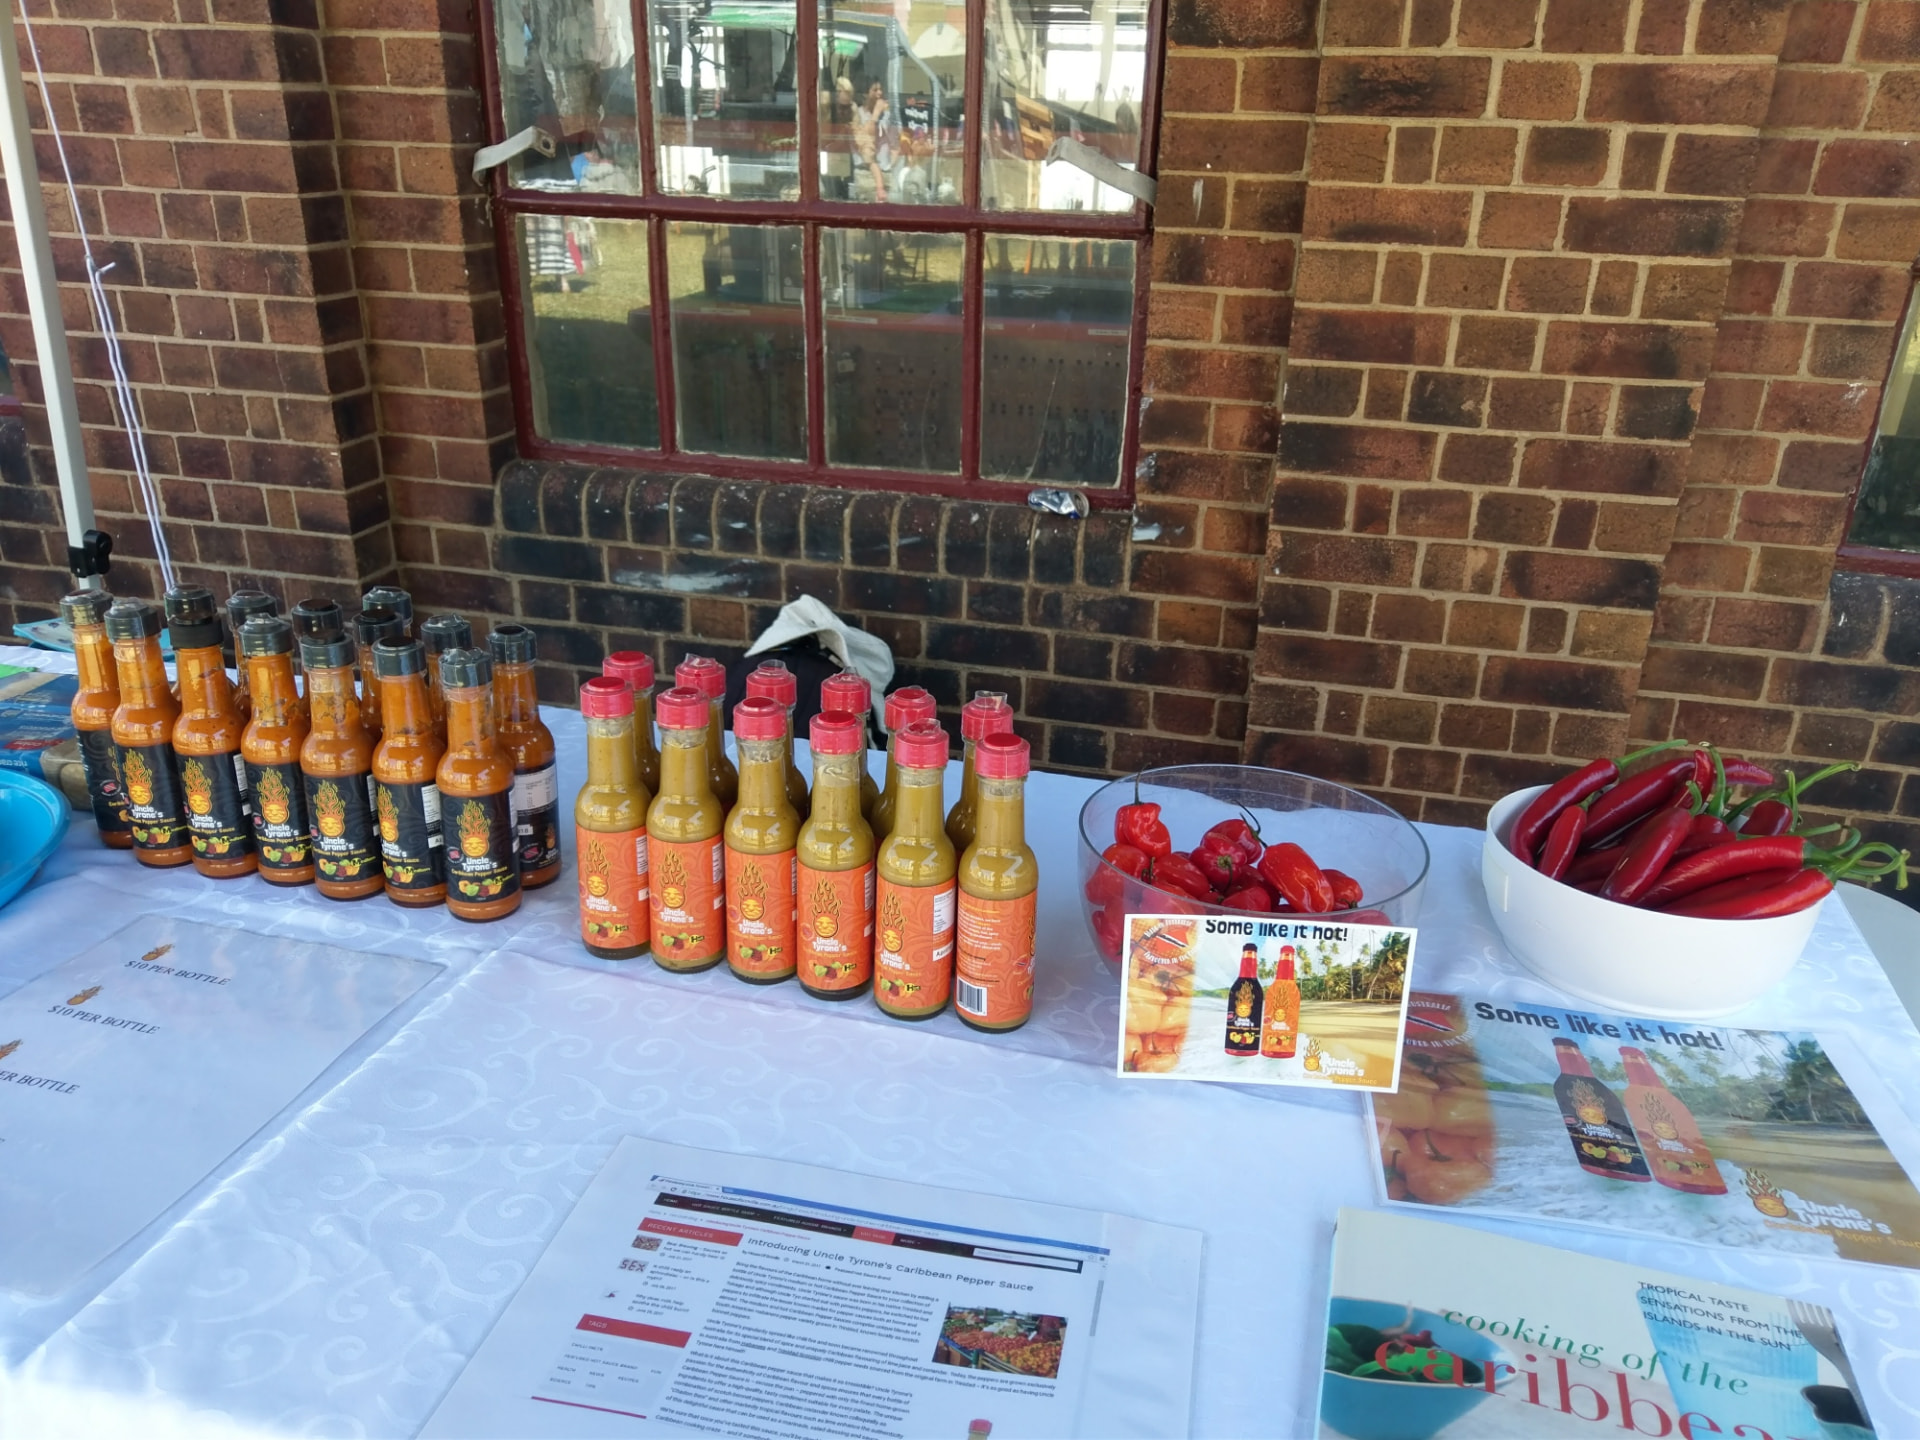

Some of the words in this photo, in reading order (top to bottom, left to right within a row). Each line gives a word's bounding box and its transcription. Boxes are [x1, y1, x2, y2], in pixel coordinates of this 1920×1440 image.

[1205, 919, 1253, 935] Some
[123, 960, 149, 970] $10
[147, 964, 175, 974] PER
[173, 969, 231, 985] BOTTLE
[47, 1004, 74, 1016] $10
[71, 1009, 101, 1022] PER
[100, 1016, 160, 1034] BOTTLE
[1474, 1001, 1560, 1030] Some
[1564, 1013, 1621, 1038] like
[1625, 1021, 1655, 1042] it
[1657, 1025, 1725, 1051] hot!
[1321, 1065, 1364, 1076] Tyrone's
[1329, 1058, 1355, 1067] Uncle
[0, 1070, 18, 1081] ER
[16, 1074, 80, 1094] BOTTLE
[1804, 1200, 1862, 1219] Uncle
[647, 1223, 675, 1233] RECENT
[678, 1228, 713, 1239] ARTICLES
[1799, 1210, 1892, 1234] Tyrone's
[620, 1259, 645, 1273] SEX
[747, 1235, 810, 1257] Introducing
[813, 1248, 845, 1263] Uncle
[848, 1254, 892, 1271] Tyrone's
[895, 1262, 952, 1280] Caribbean
[955, 1272, 995, 1290] Pepper
[998, 1279, 1034, 1293] Sauce
[1637, 1281, 1705, 1303] TROPICAL
[1708, 1296, 1750, 1312] TASTE
[588, 1321, 607, 1329] TAGS
[1640, 1295, 1725, 1321] SENSATIONS
[1730, 1315, 1769, 1331] FROM
[1774, 1324, 1803, 1339] THE
[1643, 1311, 1701, 1331] ISLANDS
[1706, 1324, 1722, 1336] IN
[1725, 1329, 1755, 1343] THE
[1760, 1337, 1792, 1351] SUN
[1444, 1309, 1604, 1369] cooking
[1621, 1350, 1668, 1381] of
[1679, 1360, 1749, 1395] the
[1375, 1341, 1804, 1440] caribbe
